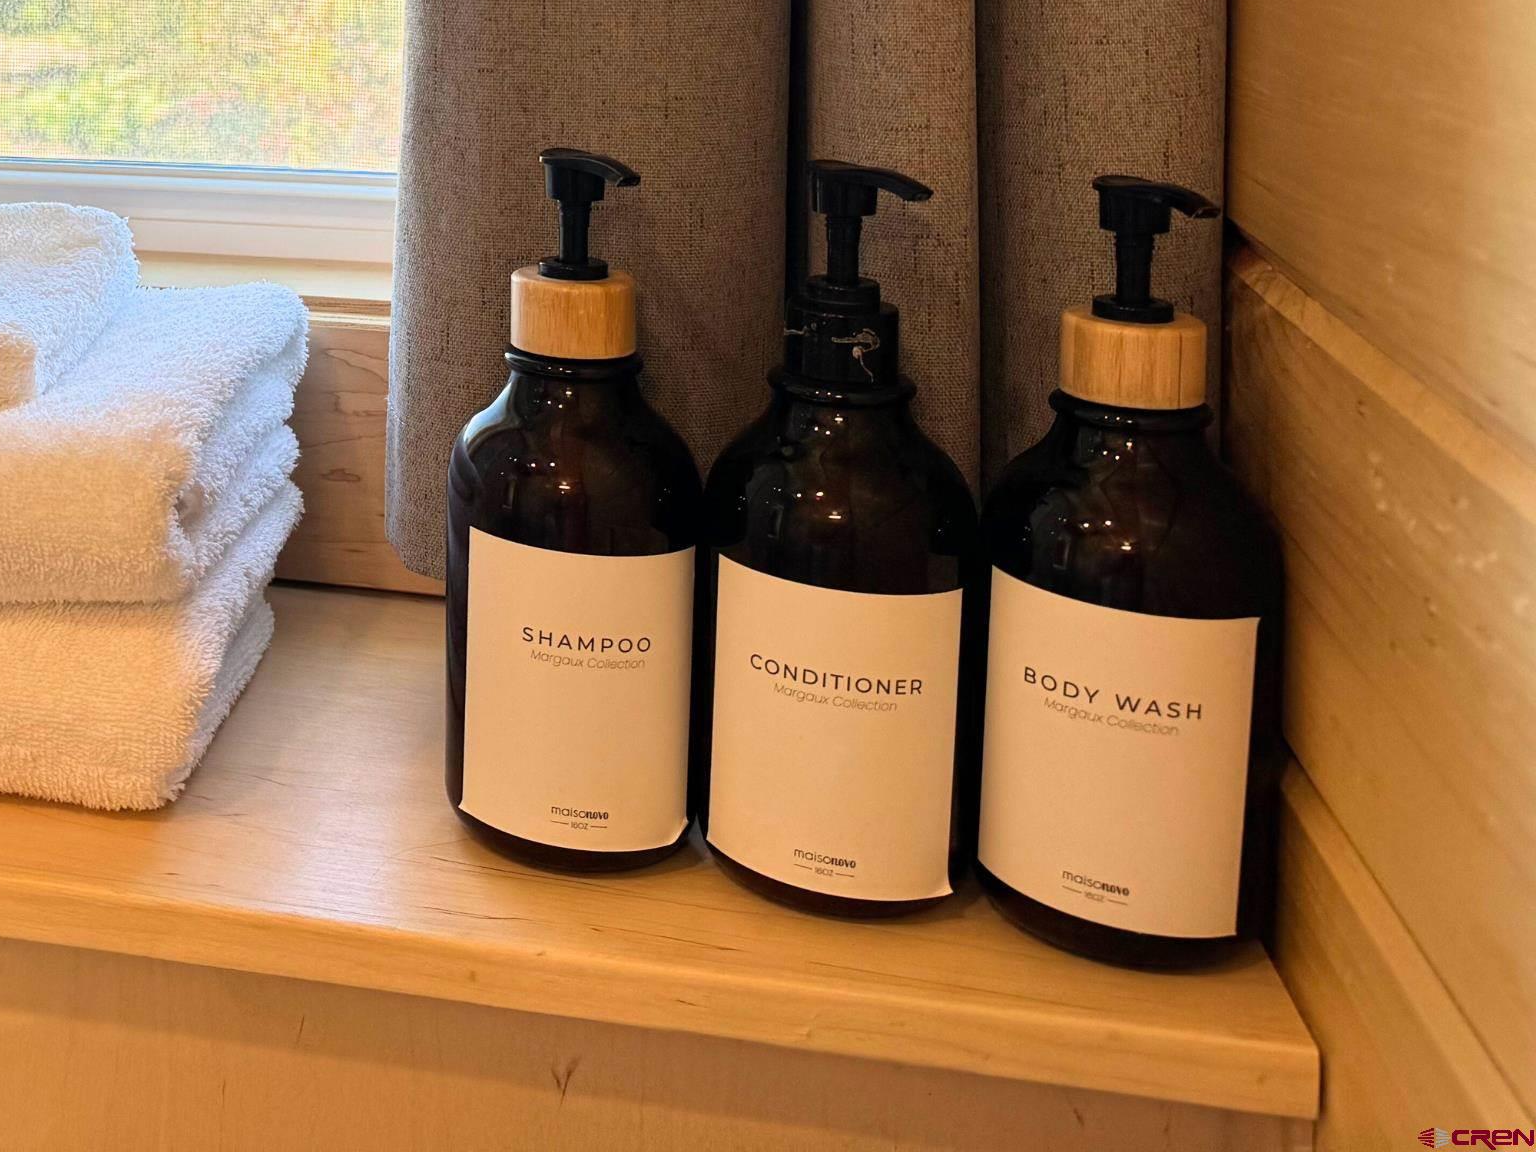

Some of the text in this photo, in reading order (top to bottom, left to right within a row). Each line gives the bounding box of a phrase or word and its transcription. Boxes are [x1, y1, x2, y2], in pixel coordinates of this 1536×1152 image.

[521, 626, 652, 654] SHAMPOO
[530, 649, 646, 670] Margaux Collection
[750, 653, 923, 696] CONDITIONER
[773, 682, 898, 713] Margaux Collection
[1023, 665, 1202, 720] BODY WASH
[1043, 696, 1180, 736] Margaux Collection
